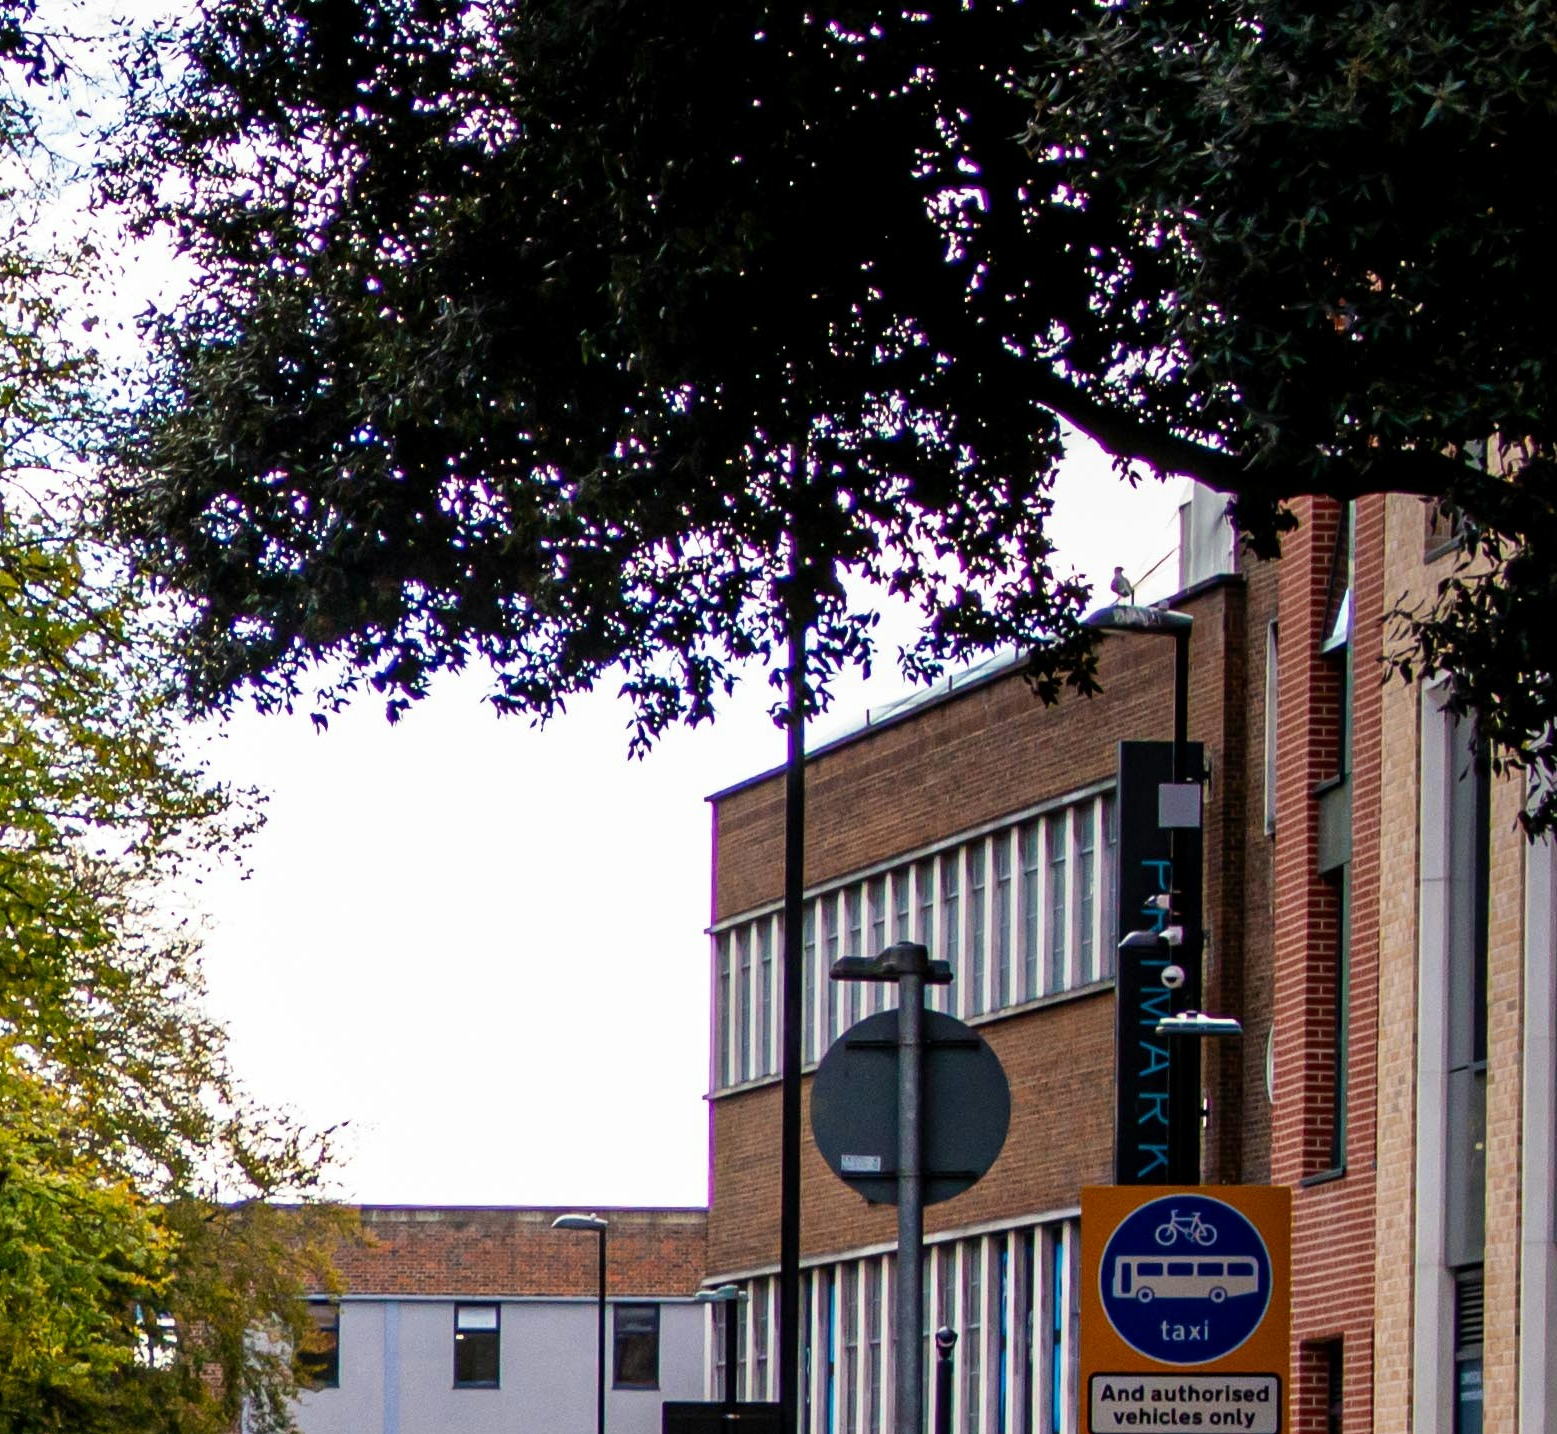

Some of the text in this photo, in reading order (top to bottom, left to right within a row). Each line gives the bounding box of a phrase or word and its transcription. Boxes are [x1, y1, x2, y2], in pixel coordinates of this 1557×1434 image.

[1160, 1319, 1210, 1341] taxi
[1100, 1383, 1270, 1402] And authorised
[1113, 1408, 1256, 1429] vehicles only
